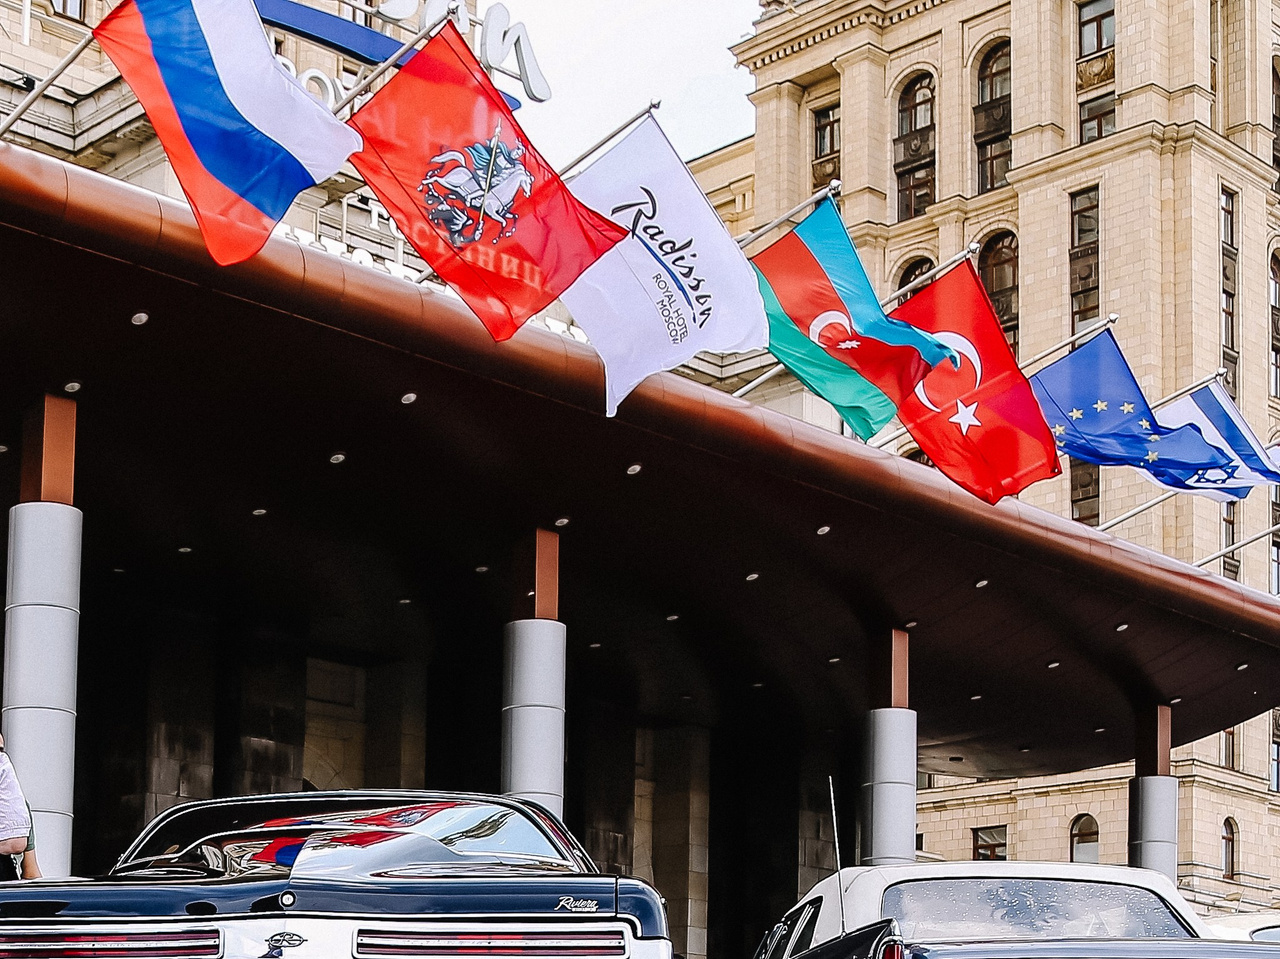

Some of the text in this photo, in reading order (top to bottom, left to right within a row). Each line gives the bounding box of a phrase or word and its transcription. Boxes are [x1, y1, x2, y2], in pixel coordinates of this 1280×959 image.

[610, 185, 713, 329] Radisson
[652, 272, 689, 342] ROYAL HOTEL
[656, 299, 680, 344] MOSCOW
[553, 896, 599, 911] Riviera
